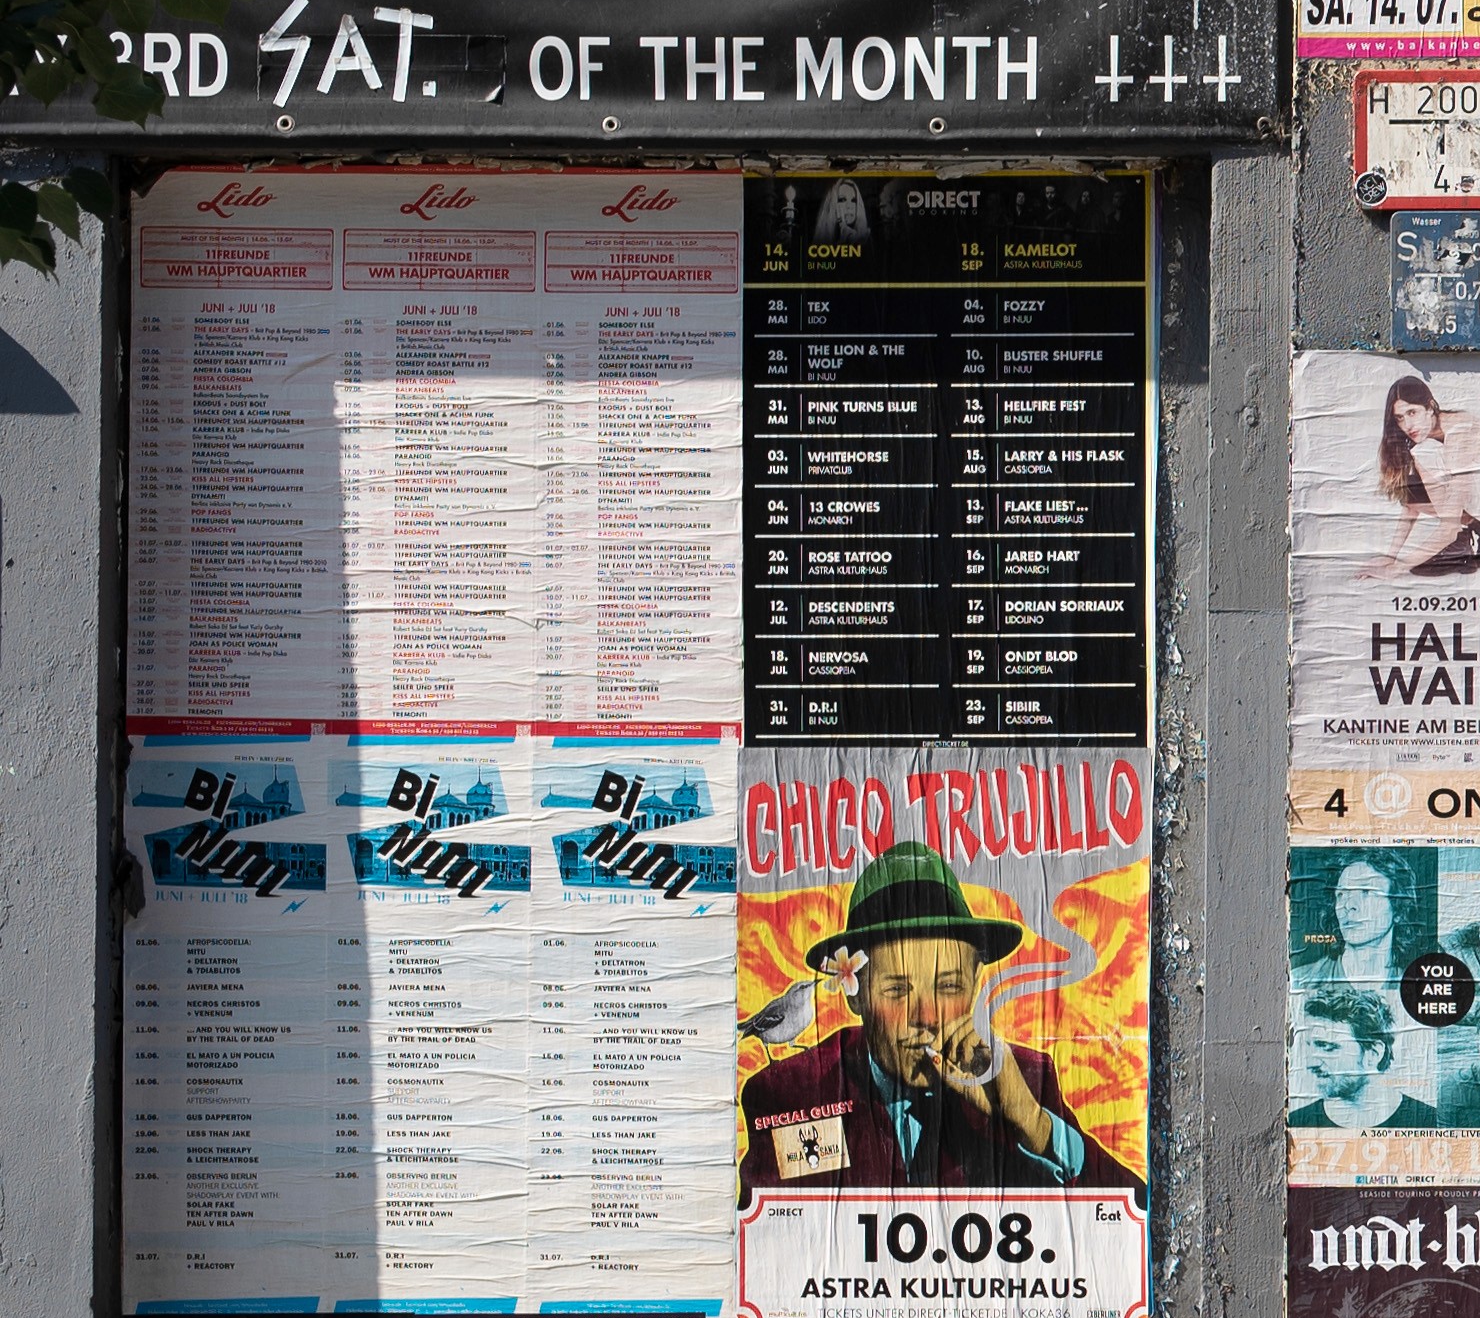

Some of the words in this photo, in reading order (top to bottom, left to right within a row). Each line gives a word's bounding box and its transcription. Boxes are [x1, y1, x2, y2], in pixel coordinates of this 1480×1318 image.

[529, 36, 611, 100] OF
[640, 36, 764, 100] THE
[794, 36, 1038, 100] MONTH
[1369, 89, 1389, 114] H
[1417, 86, 1478, 114] 200
[1434, 165, 1450, 193] 4
[602, 185, 681, 222] Lido
[1412, 217, 1441, 226] Wasser
[808, 244, 862, 258] COVEN
[1004, 243, 1077, 257] KAMELOT
[1397, 232, 1417, 261] S
[610, 254, 674, 263] 11FREUNDE
[570, 270, 597, 280] WM
[602, 270, 712, 281] HAUPTQUARTIER
[605, 308, 628, 317] JUNI
[643, 307, 662, 317] JULI
[1004, 301, 1046, 312] FOZZY
[808, 401, 835, 413] PINK
[839, 401, 884, 413] TURNS
[887, 401, 917, 413] BLUE
[808, 451, 889, 463] WHITEHORSE
[808, 551, 837, 563] ROSE
[840, 551, 892, 563] TATTOO
[809, 601, 895, 613] DESCENDENTS
[1005, 601, 1047, 612] DORIAN
[1050, 601, 1124, 612] SORRIAUX
[809, 651, 869, 663] NERVOSA
[1324, 788, 1348, 818] 4
[744, 777, 895, 877] CHICO
[907, 759, 1145, 865] TRUJILLO
[1420, 965, 1454, 979] YOU
[1423, 984, 1452, 997] ARE
[1417, 1003, 1457, 1015] HERE
[858, 1213, 1056, 1264] 10.08.
[802, 1278, 891, 1299] ASTRA
[901, 1277, 1088, 1299] KULTURHAUS
